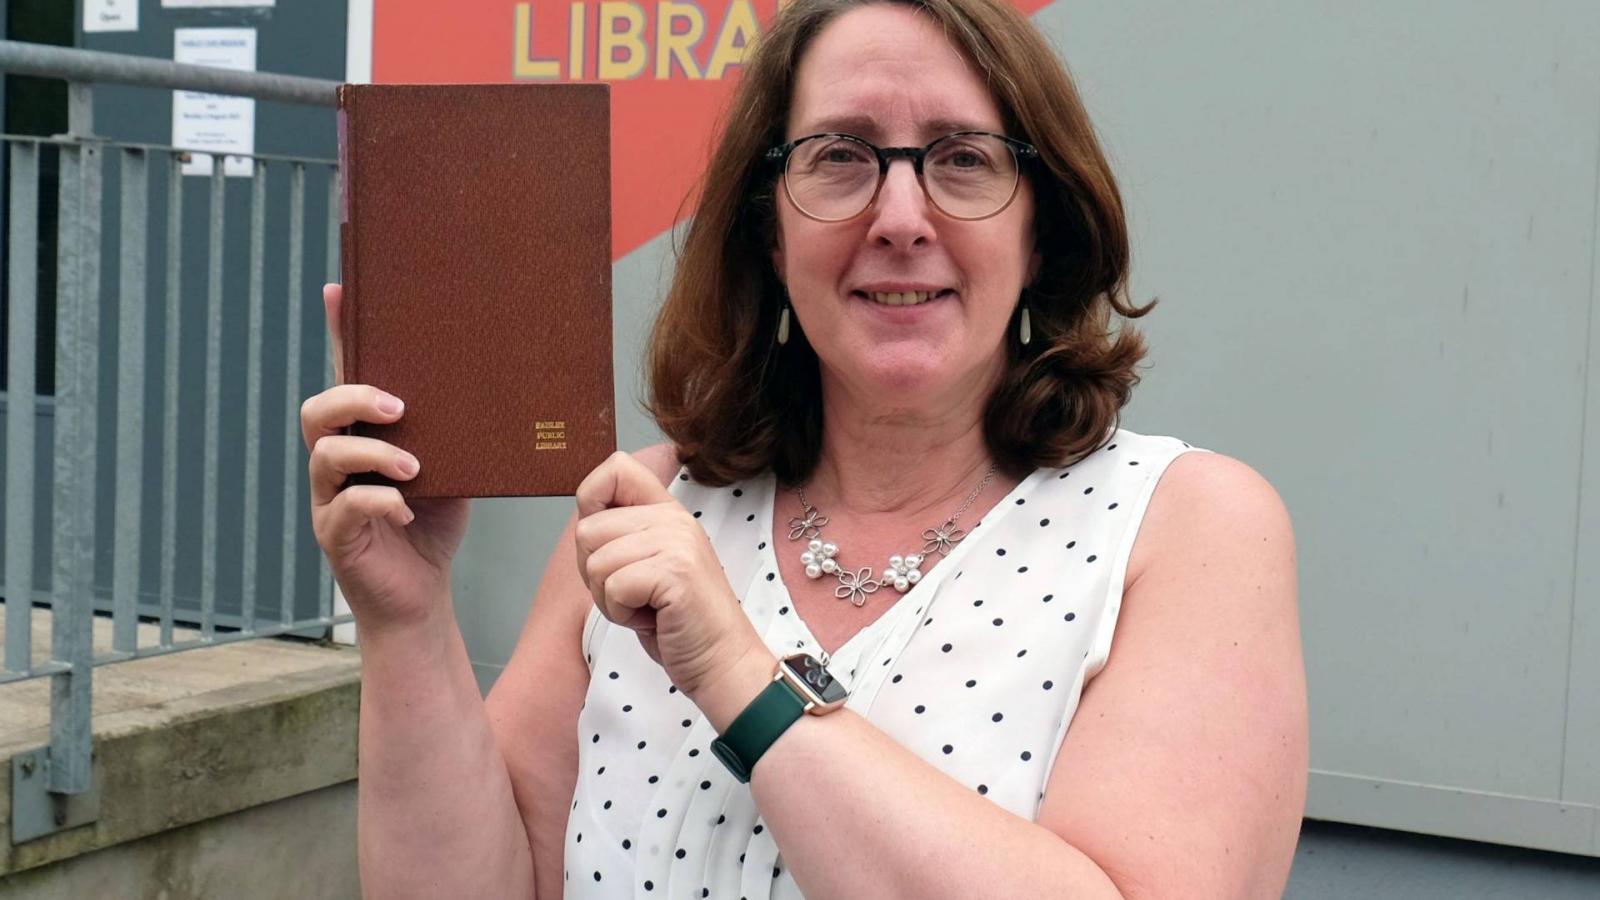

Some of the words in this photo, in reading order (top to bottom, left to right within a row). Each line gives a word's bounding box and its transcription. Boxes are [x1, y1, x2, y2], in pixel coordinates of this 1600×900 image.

[513, 0, 782, 79] LIBRA
[537, 431, 565, 439] PUBLIC
[535, 442, 567, 450] LIBRARY
